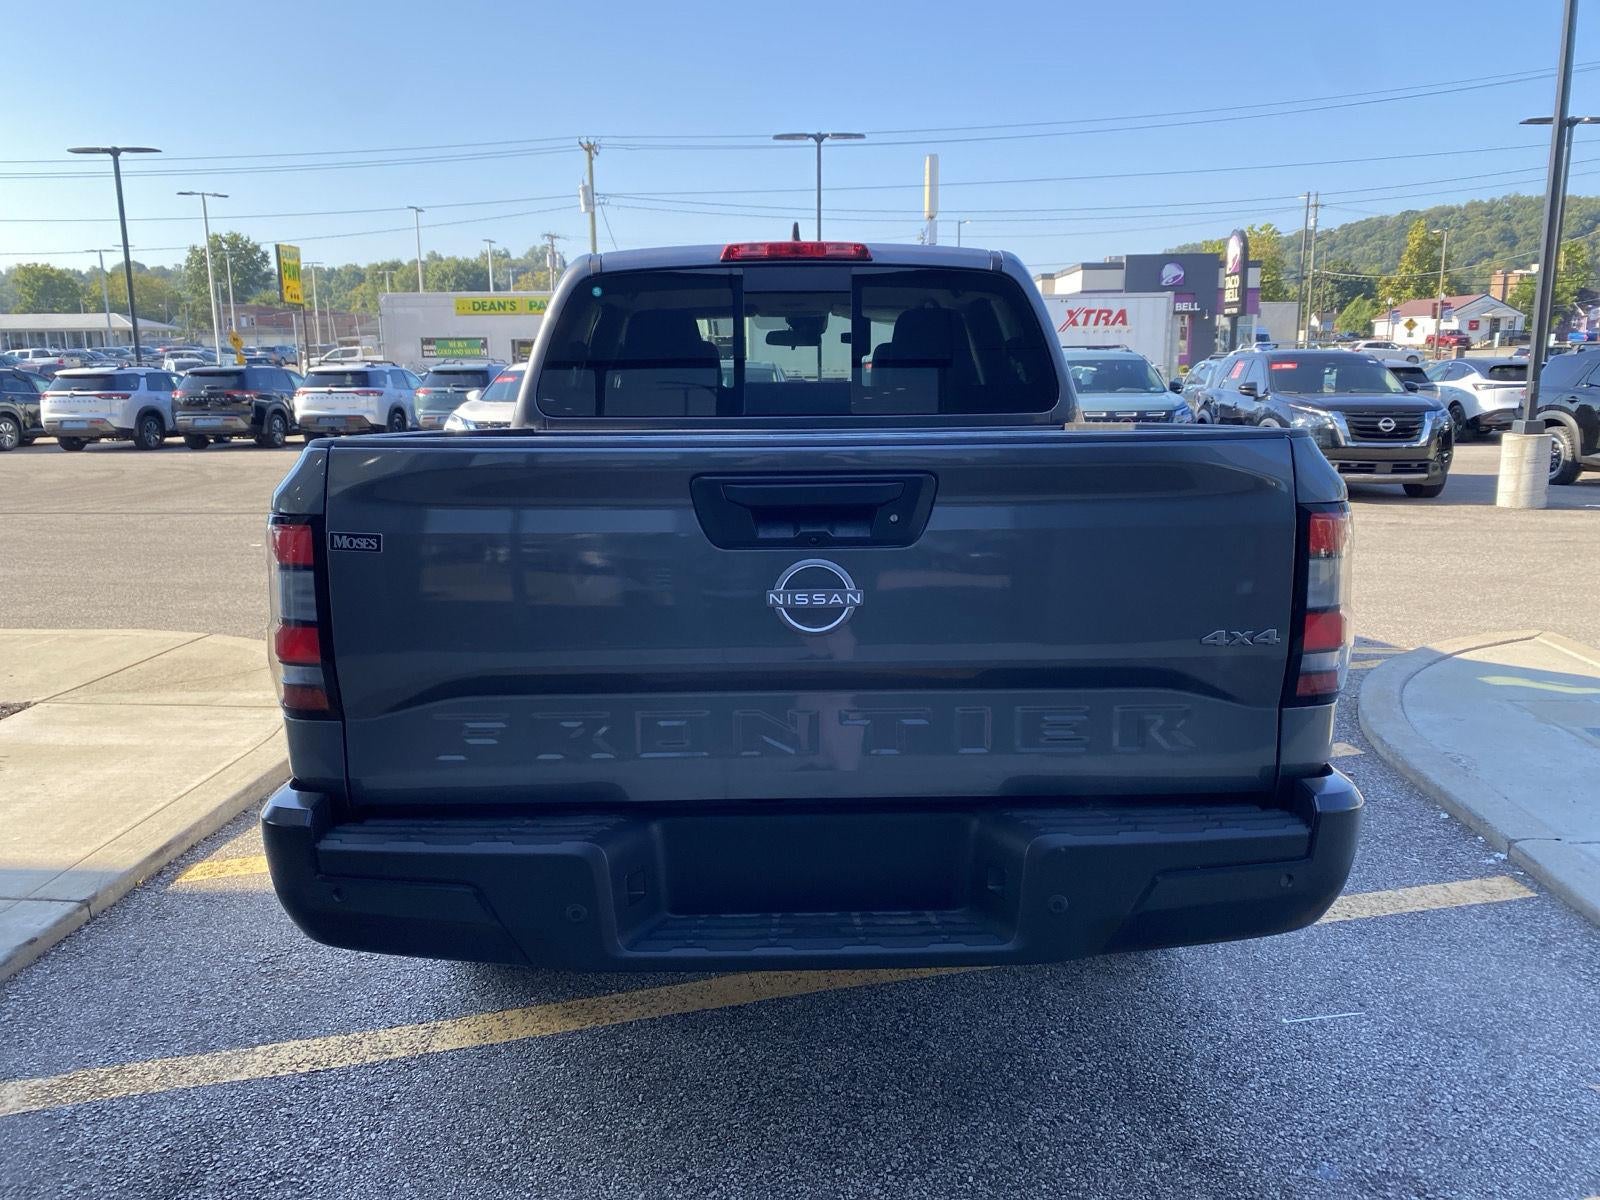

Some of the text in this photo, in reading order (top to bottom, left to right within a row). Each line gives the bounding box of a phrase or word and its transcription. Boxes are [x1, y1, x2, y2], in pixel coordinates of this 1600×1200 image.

[1225, 275, 1240, 289] TACO
[1224, 288, 1239, 303] BELL
[1175, 302, 1201, 312] BELL
[1058, 307, 1128, 332] XTRA
[769, 593, 861, 605] NISSAN
[432, 704, 1195, 760] FRONTIER
